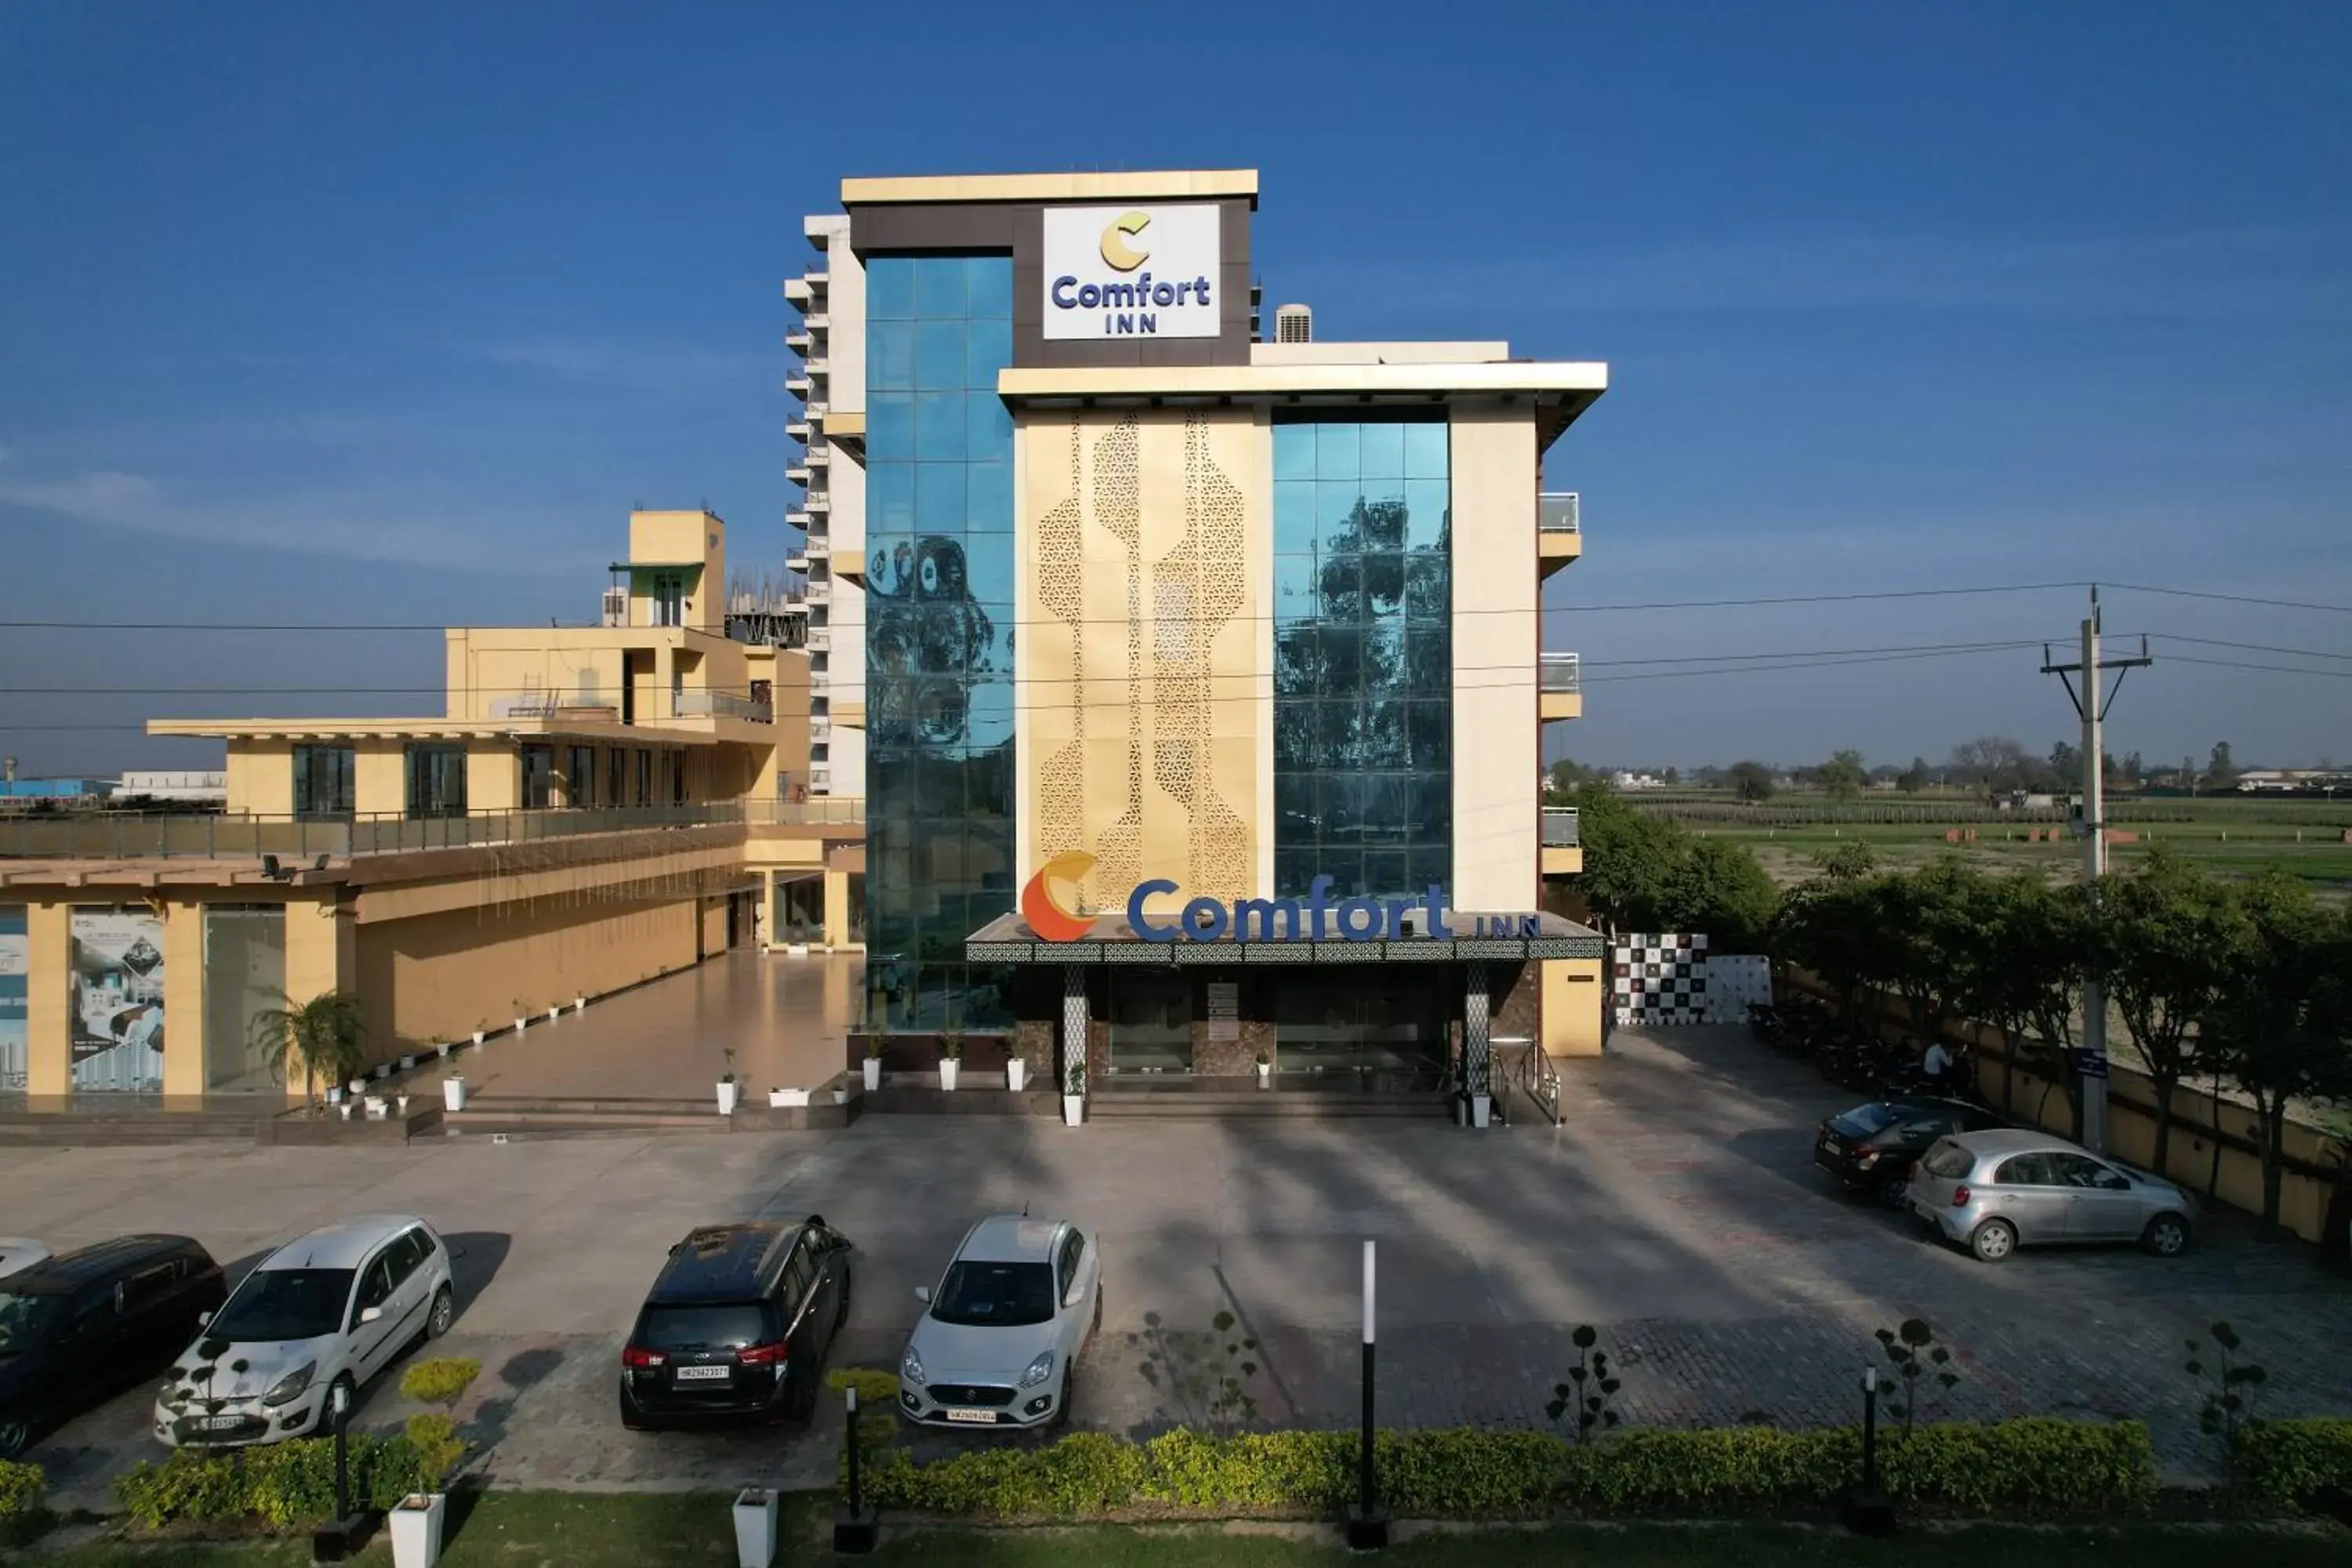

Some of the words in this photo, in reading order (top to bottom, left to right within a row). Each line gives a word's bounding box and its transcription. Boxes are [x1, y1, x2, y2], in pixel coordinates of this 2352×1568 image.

[1051, 272, 1210, 309] Comfort
[1105, 314, 1156, 334] INN
[1127, 873, 1453, 942] Comfort
[1476, 914, 1541, 938] INN
